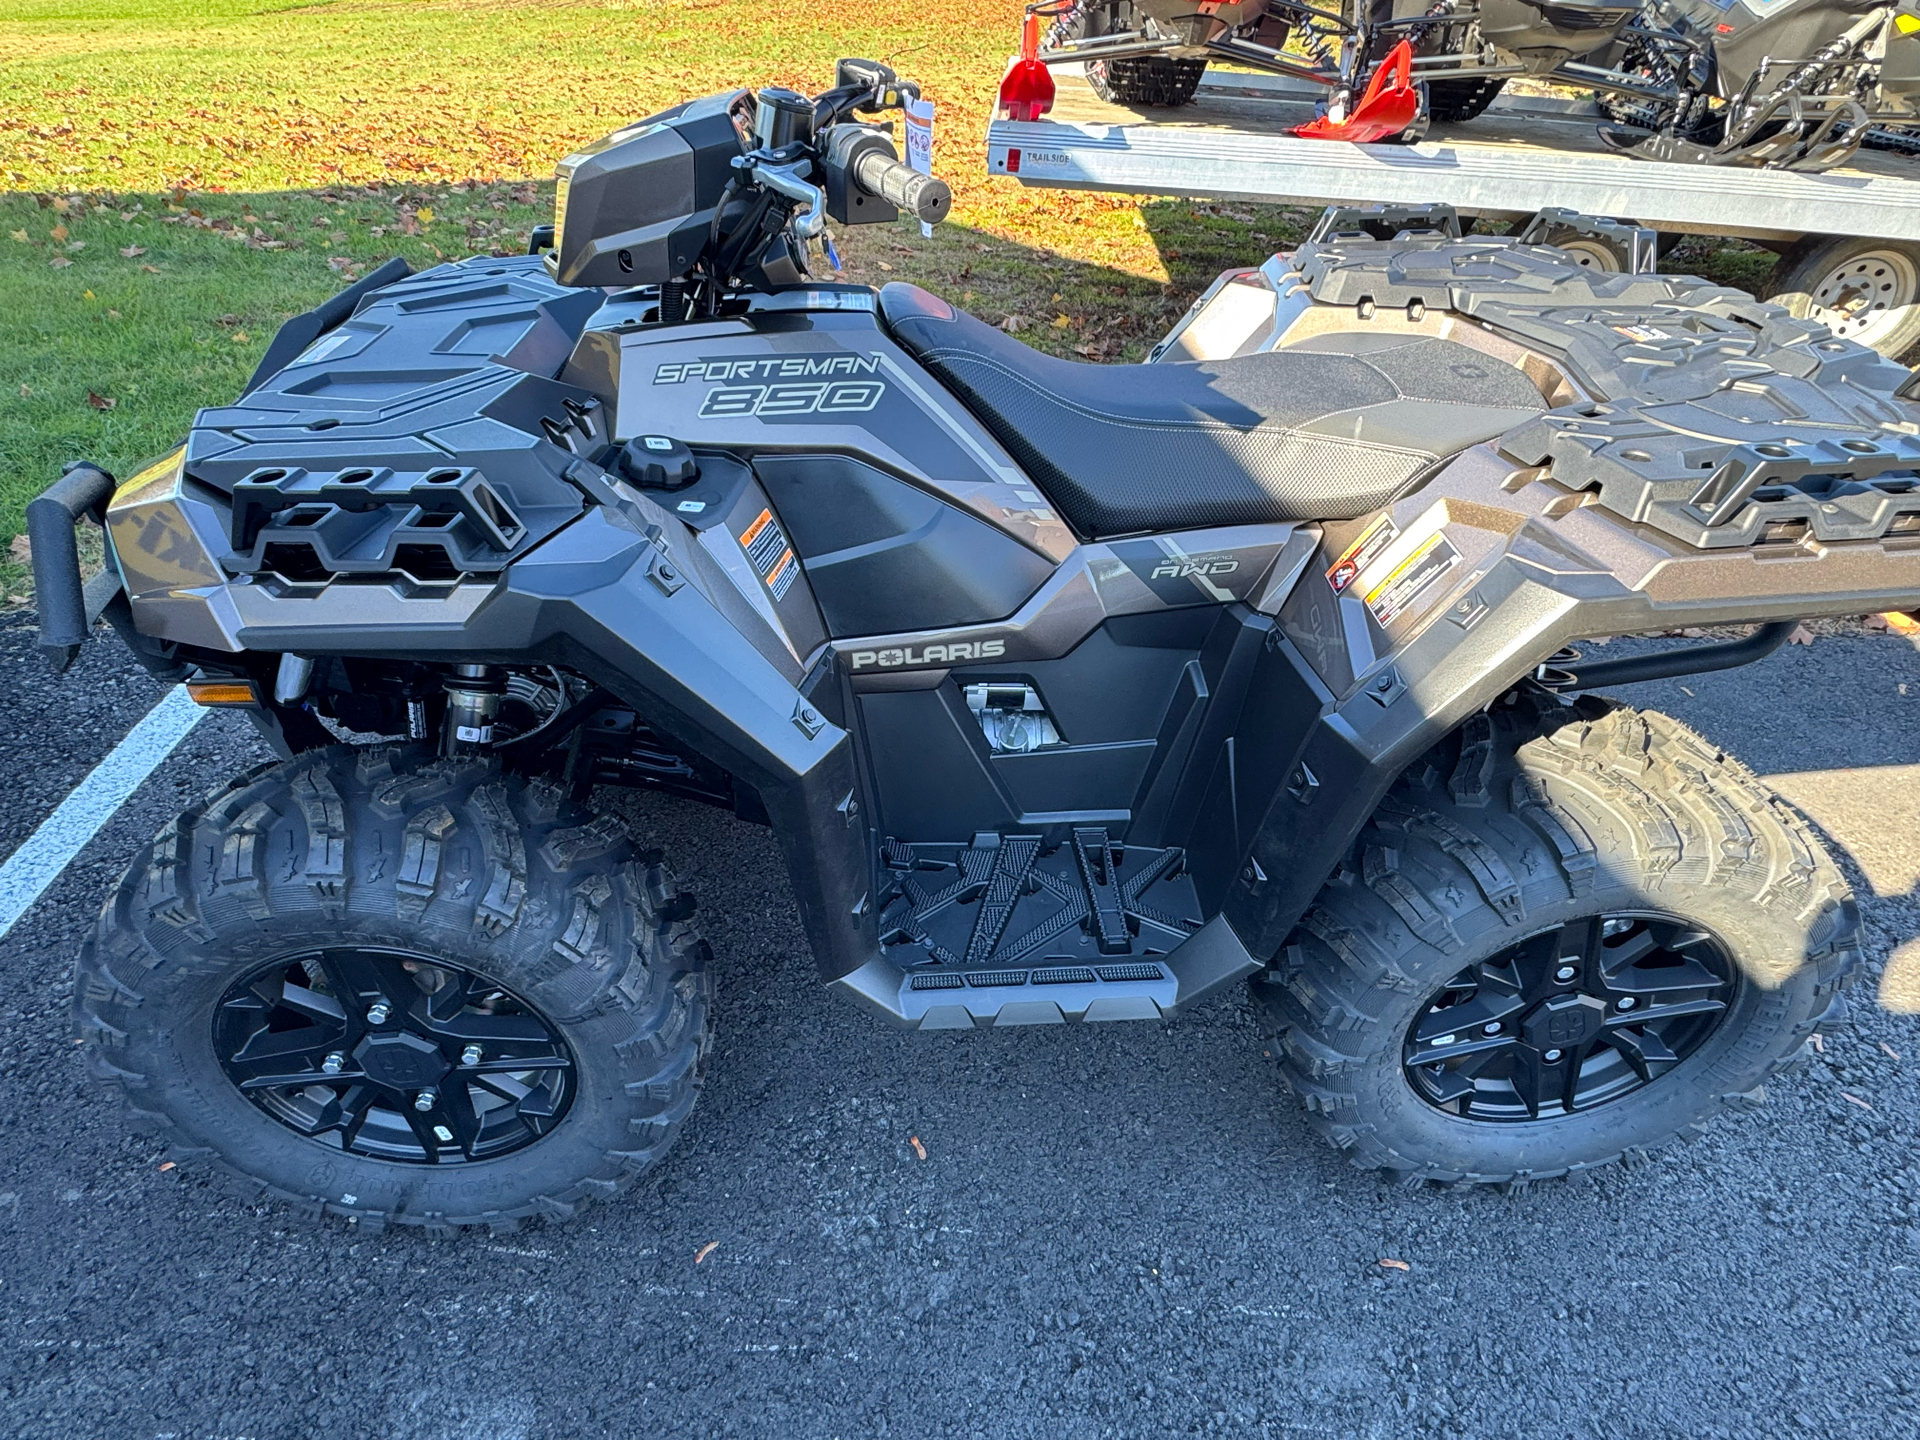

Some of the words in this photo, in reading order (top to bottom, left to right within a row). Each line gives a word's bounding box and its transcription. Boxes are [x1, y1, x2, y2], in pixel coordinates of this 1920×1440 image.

[1027, 152, 1070, 163] TRAILSIDE
[654, 356, 881, 384] SPORTSMAN
[697, 381, 886, 419] 850
[1151, 560, 1240, 580] AWD
[852, 639, 1006, 669] POLARIS
